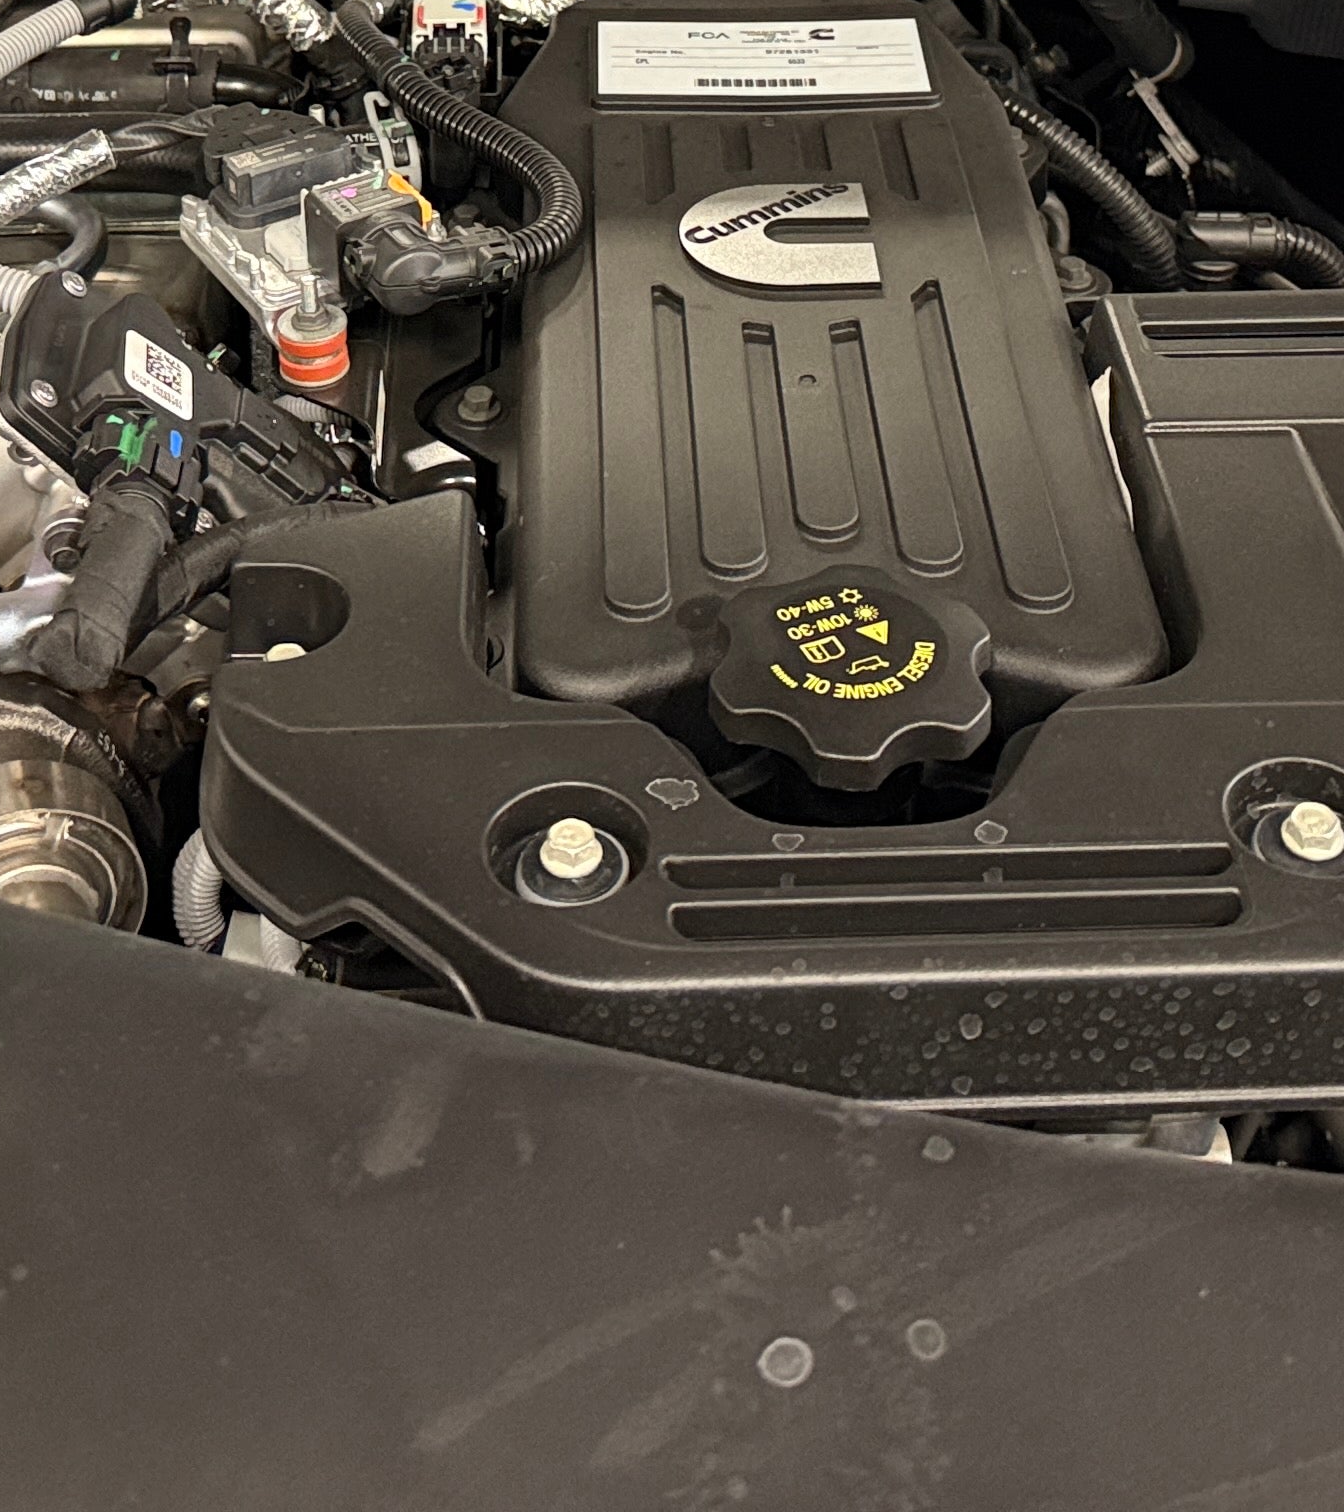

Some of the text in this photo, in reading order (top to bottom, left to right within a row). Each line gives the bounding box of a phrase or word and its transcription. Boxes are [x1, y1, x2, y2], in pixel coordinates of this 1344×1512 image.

[687, 31, 730, 39] FCA
[683, 183, 849, 244] Cummins
[776, 595, 835, 622] 5W-40
[787, 613, 853, 640] 10W-30
[896, 641, 936, 682] DIESEL
[803, 673, 831, 695] OIL
[832, 676, 905, 700] ENGINE
